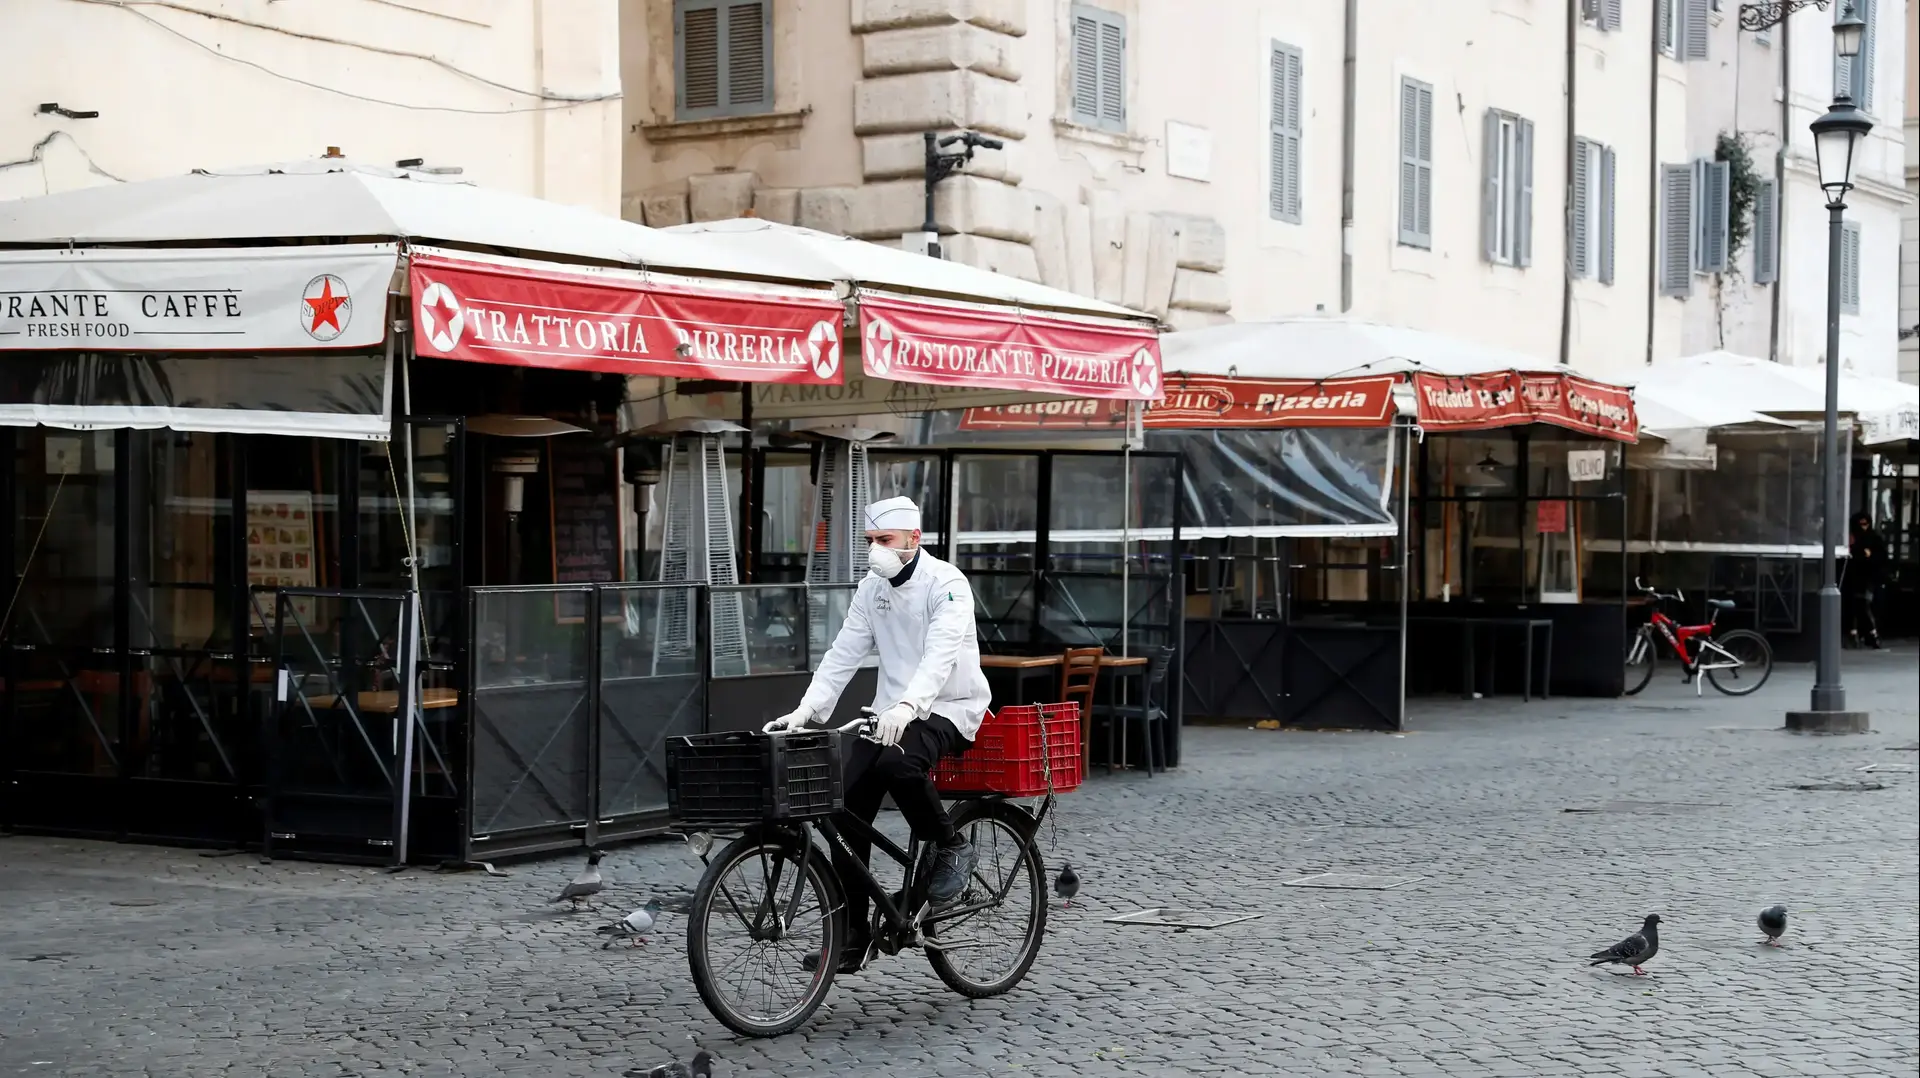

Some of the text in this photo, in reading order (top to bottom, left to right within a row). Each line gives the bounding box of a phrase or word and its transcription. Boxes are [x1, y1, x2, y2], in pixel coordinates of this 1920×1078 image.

[0, 289, 242, 318] RANTE CAFFÈ
[27, 322, 130, 337] FRESH FOOD
[466, 306, 649, 354] TRATTORIA
[896, 338, 1130, 386] RISTORANTE PIZZERIA
[984, 399, 1099, 415] attoria
[1255, 391, 1368, 413] Pizzeria
